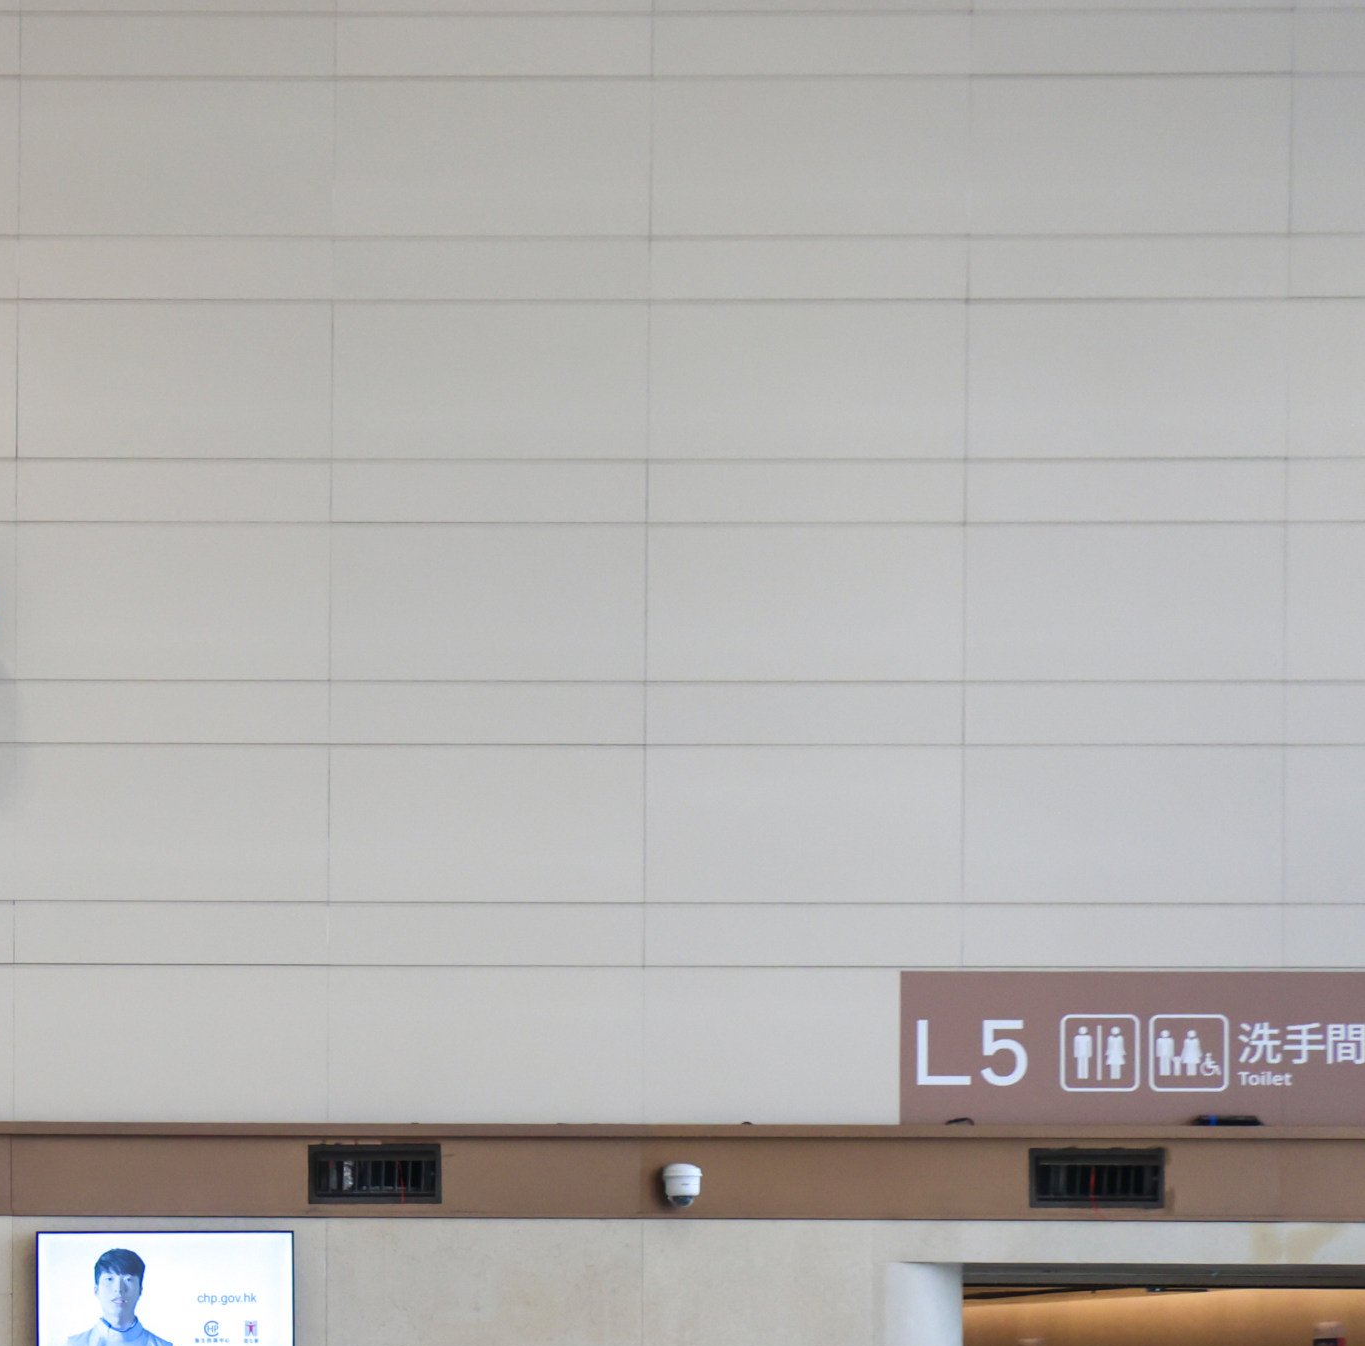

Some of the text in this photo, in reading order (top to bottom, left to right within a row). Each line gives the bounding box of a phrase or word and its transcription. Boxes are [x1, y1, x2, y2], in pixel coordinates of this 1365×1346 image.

[916, 1018, 1029, 1087] L5
[1237, 1021, 1365, 1066] 洗手間
[1237, 1070, 1293, 1087] Toilet
[197, 1292, 258, 1306] chp.gov.hk
